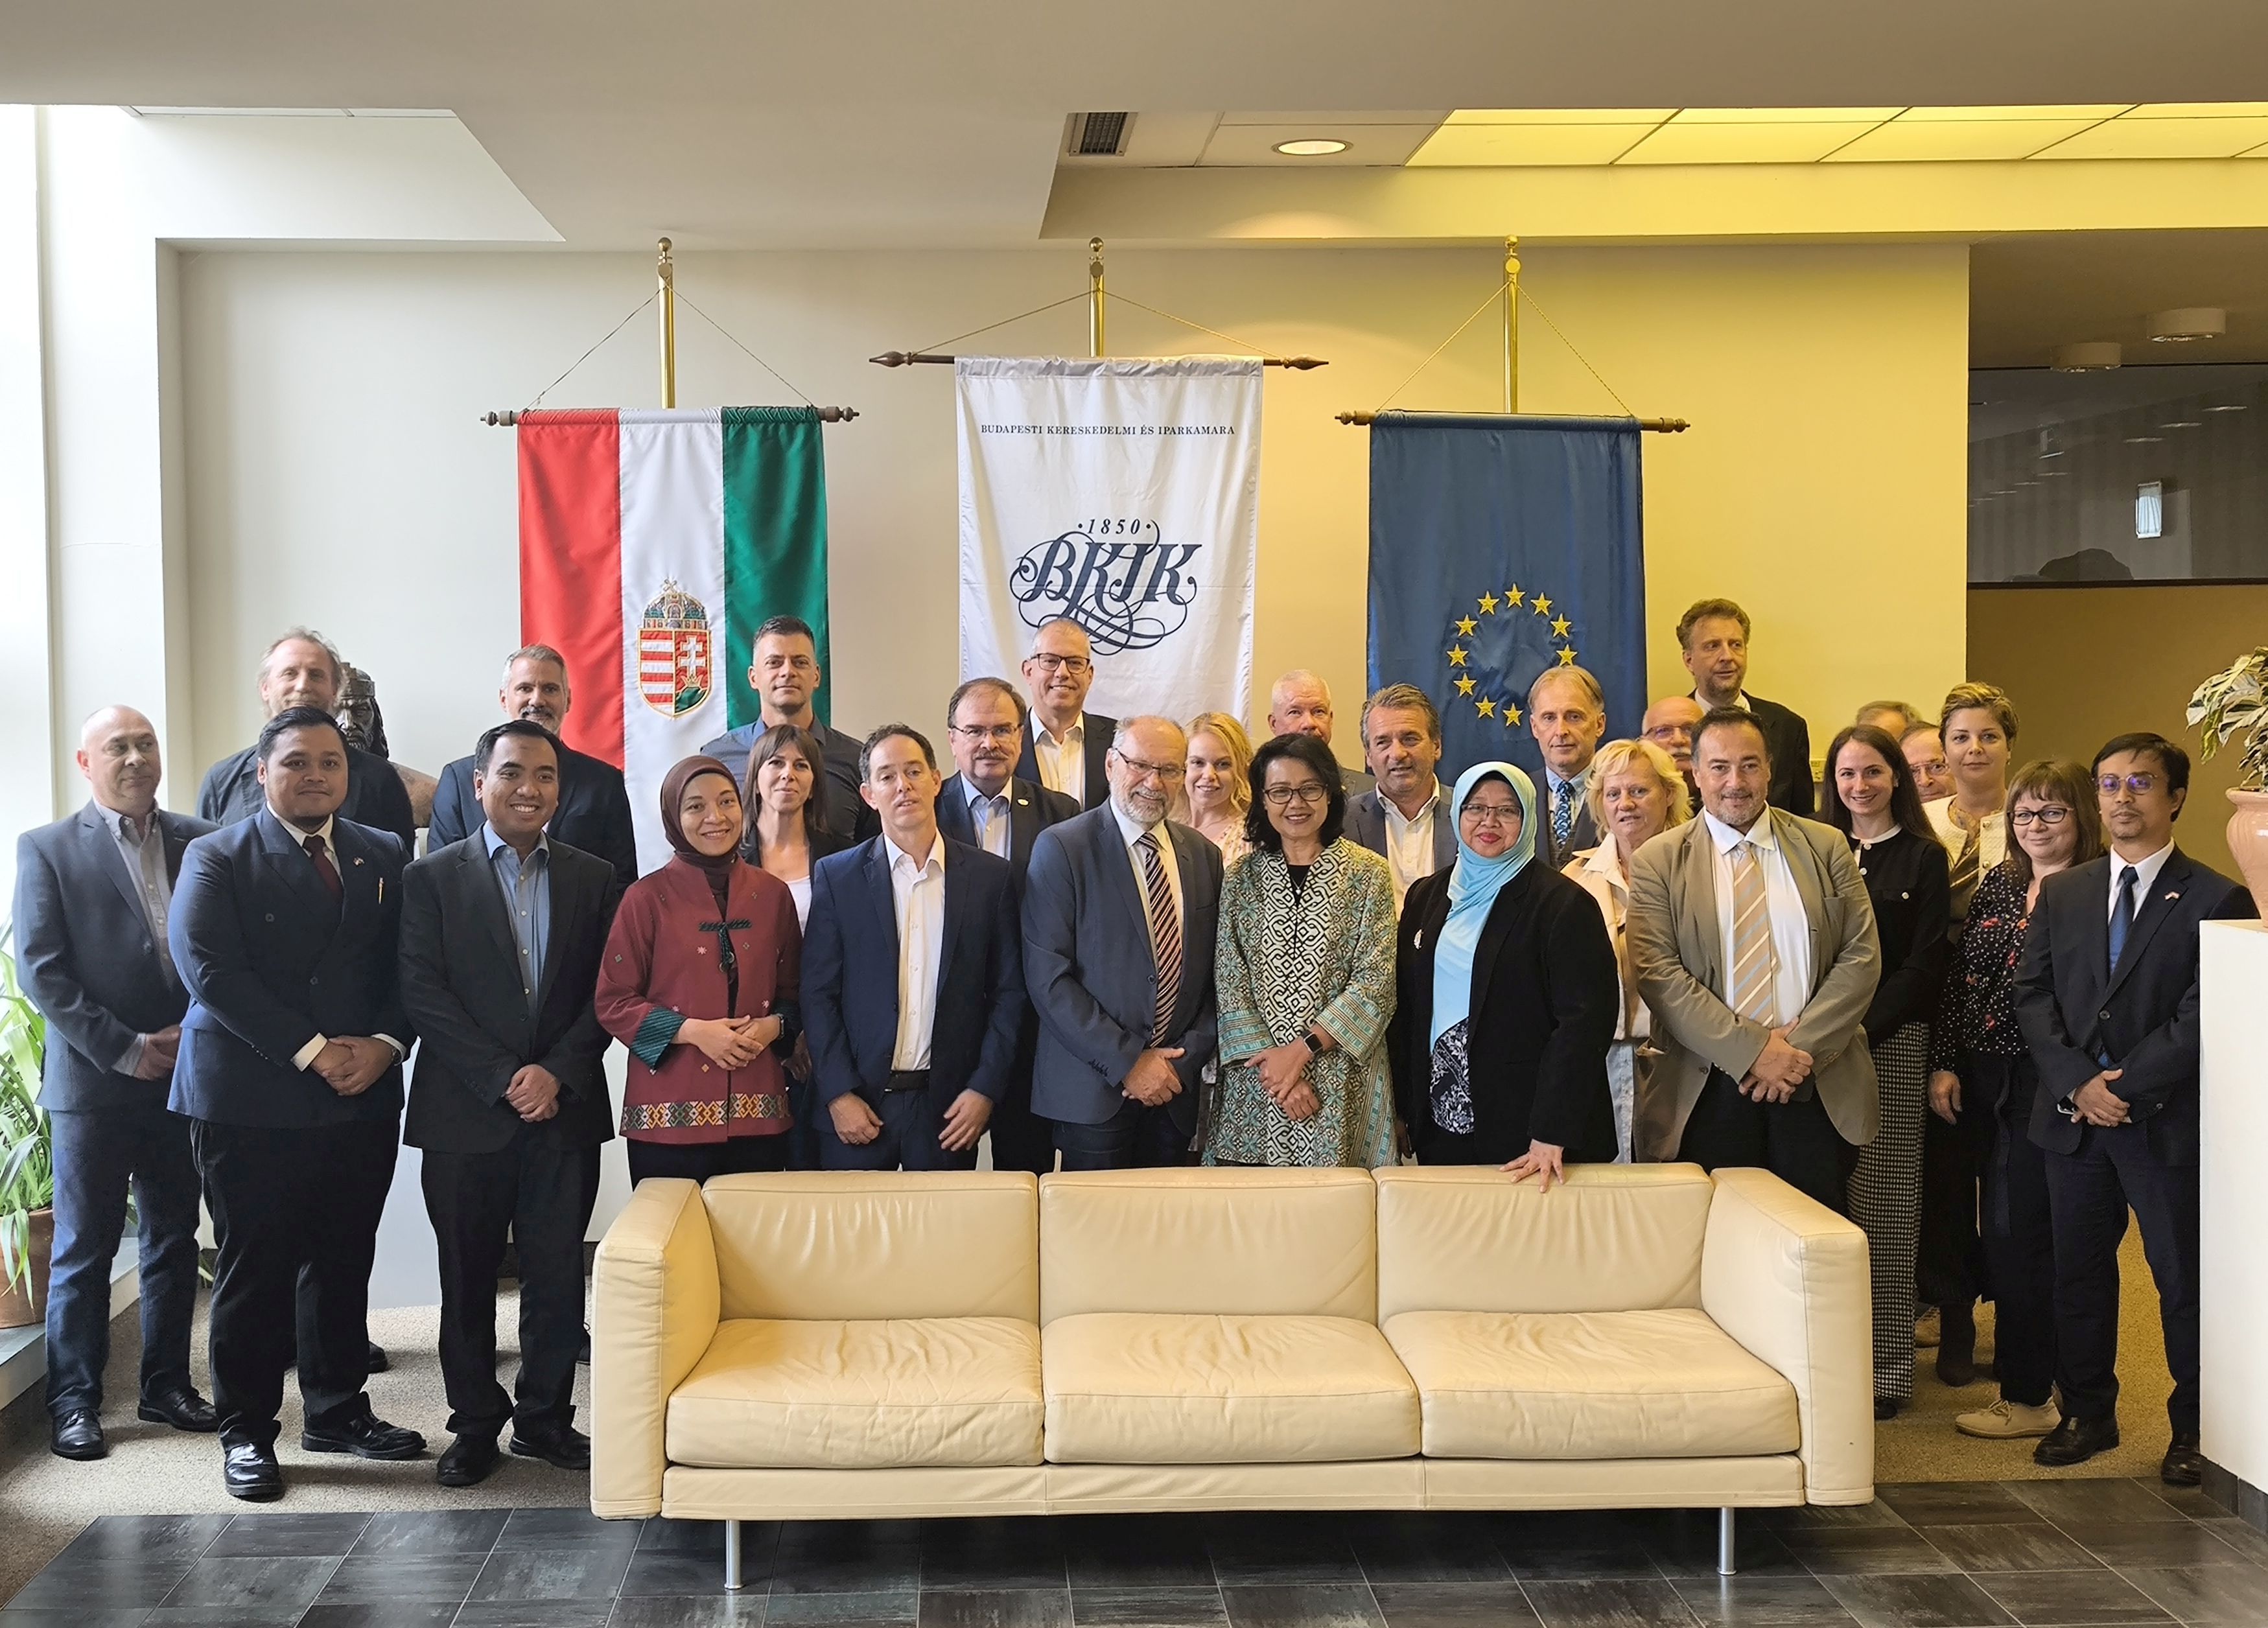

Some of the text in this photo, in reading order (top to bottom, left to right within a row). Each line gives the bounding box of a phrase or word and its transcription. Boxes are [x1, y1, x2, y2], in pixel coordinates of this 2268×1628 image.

[981, 423, 1235, 435] BUDAPESTI KERESKEDELMI ÉS IPARKAMARA
[1086, 518, 1141, 535] 1850
